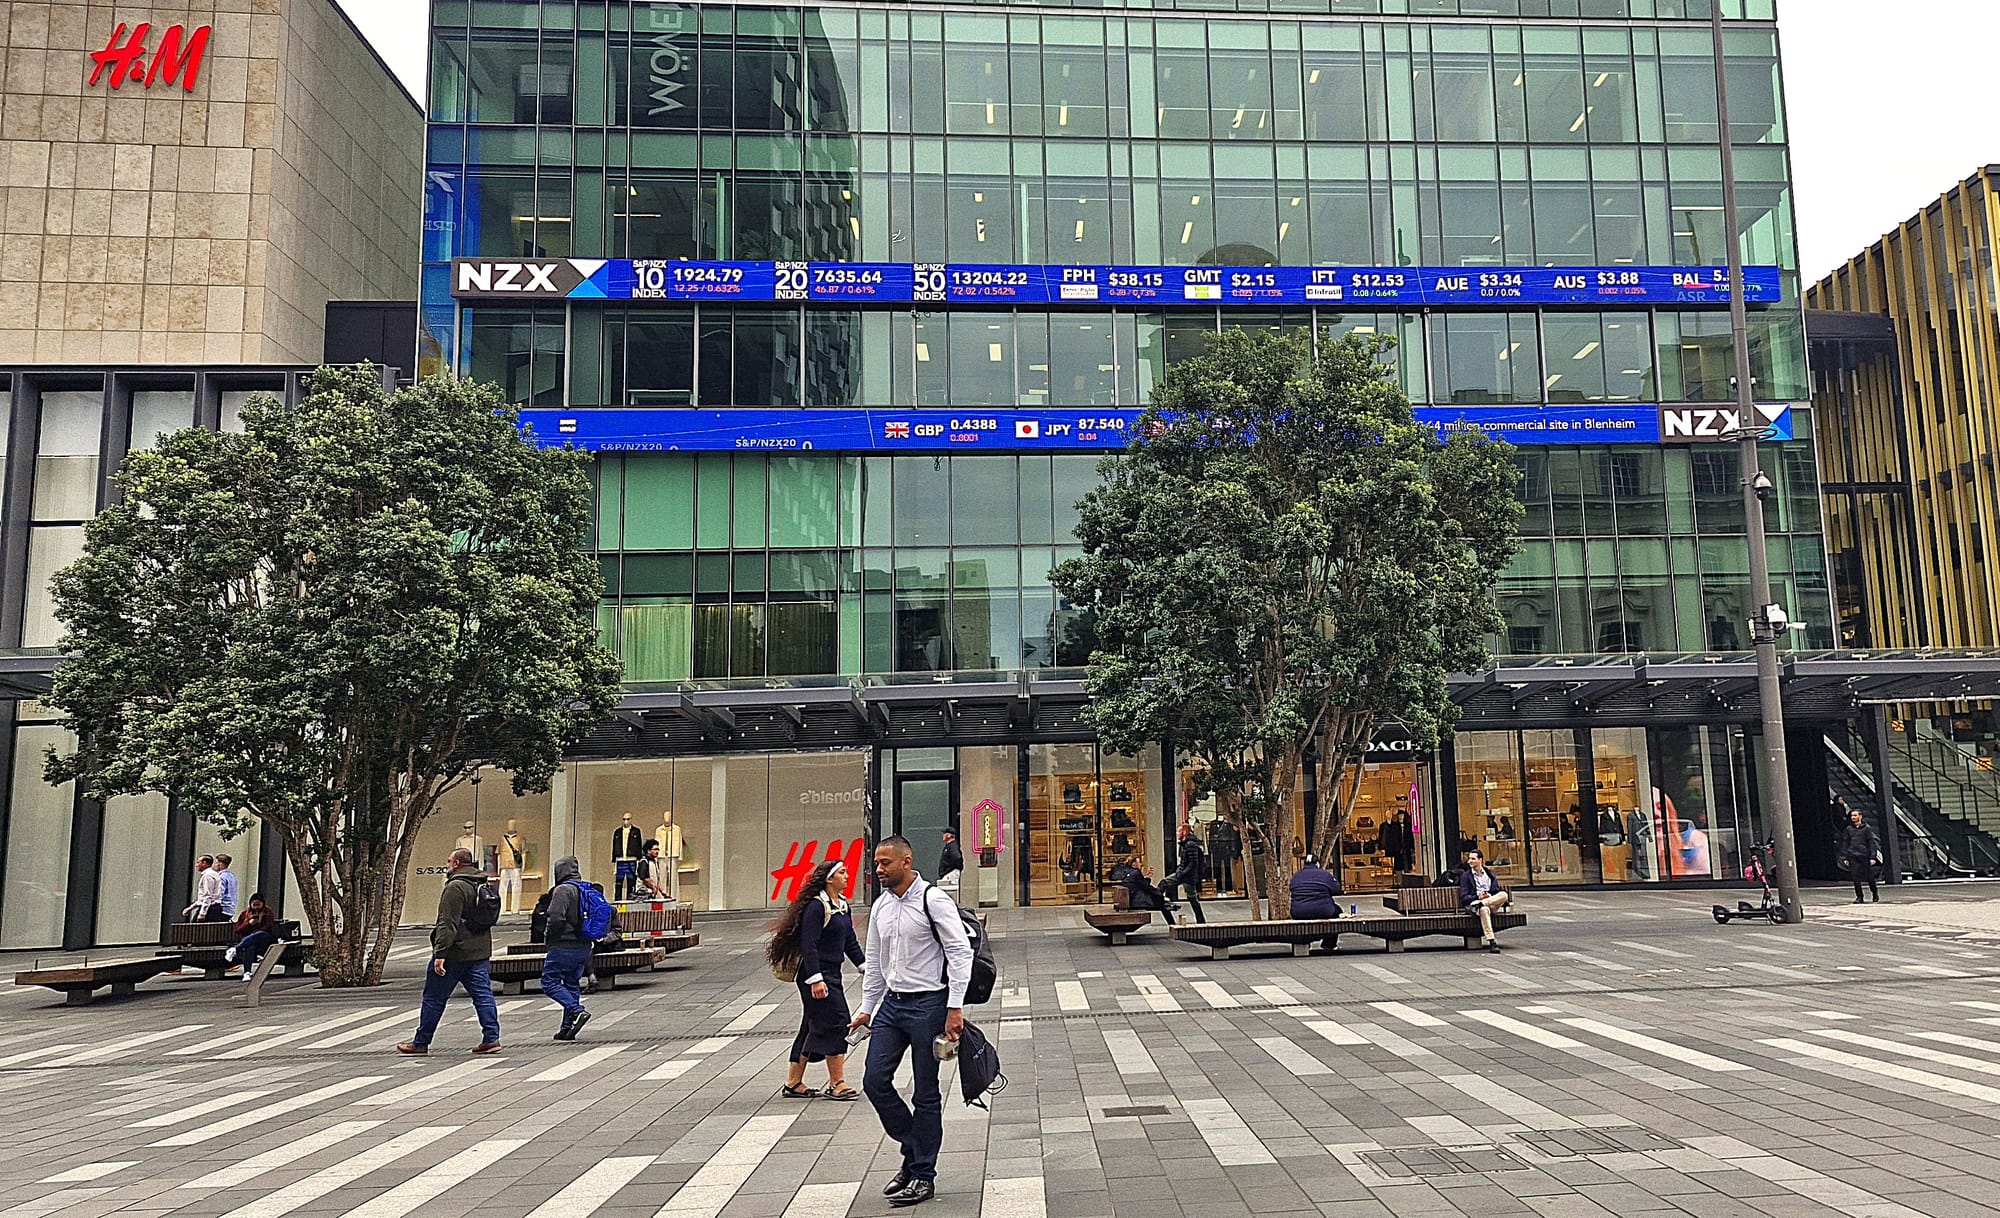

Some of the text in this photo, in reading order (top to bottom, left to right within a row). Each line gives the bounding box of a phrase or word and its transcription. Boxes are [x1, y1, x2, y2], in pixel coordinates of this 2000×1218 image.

[89, 22, 211, 93] H&M
[633, 260, 667, 268] S&P/NZX
[775, 262, 808, 270] S&P/NZX
[458, 263, 558, 292] NZX
[635, 268, 665, 289] 10
[673, 268, 743, 282] 1924.79
[775, 270, 808, 290] 20
[814, 270, 882, 283] 7635.64
[913, 272, 946, 291] 50
[952, 272, 1028, 285] 13204.22
[1063, 269, 1096, 282] FPH
[1109, 272, 1163, 287] $38.15
[1184, 269, 1222, 283] GMT
[1231, 273, 1275, 288] $2.15
[1312, 270, 1336, 283] IFT
[1352, 273, 1404, 288] $12.53
[1480, 273, 1523, 287] $3.34
[1597, 272, 1639, 285] $3.88
[674, 284, 699, 292] 12.25
[707, 285, 741, 293] 0.632%
[1435, 278, 1469, 291] AUE
[1553, 276, 1586, 289] AUS
[632, 289, 667, 298] INDEX
[775, 291, 808, 299] INDEX
[815, 286, 839, 294] 46.87
[847, 286, 876, 294] 0.61%
[913, 291, 946, 300] INDEX
[1481, 288, 1493, 296] 0.0
[1501, 288, 1521, 297] 0.0%
[914, 424, 944, 436] GBP
[950, 419, 997, 430] 0.4388
[1044, 424, 1071, 436] JPY
[1078, 418, 1124, 430] 87.540
[1484, 419, 1546, 431] commercial
[1549, 419, 1569, 430] site
[1571, 419, 1581, 429] in
[1584, 418, 1635, 429] Blenheim
[735, 438, 797, 447] S&P/NZX20
[416, 866, 434, 875] S/S
